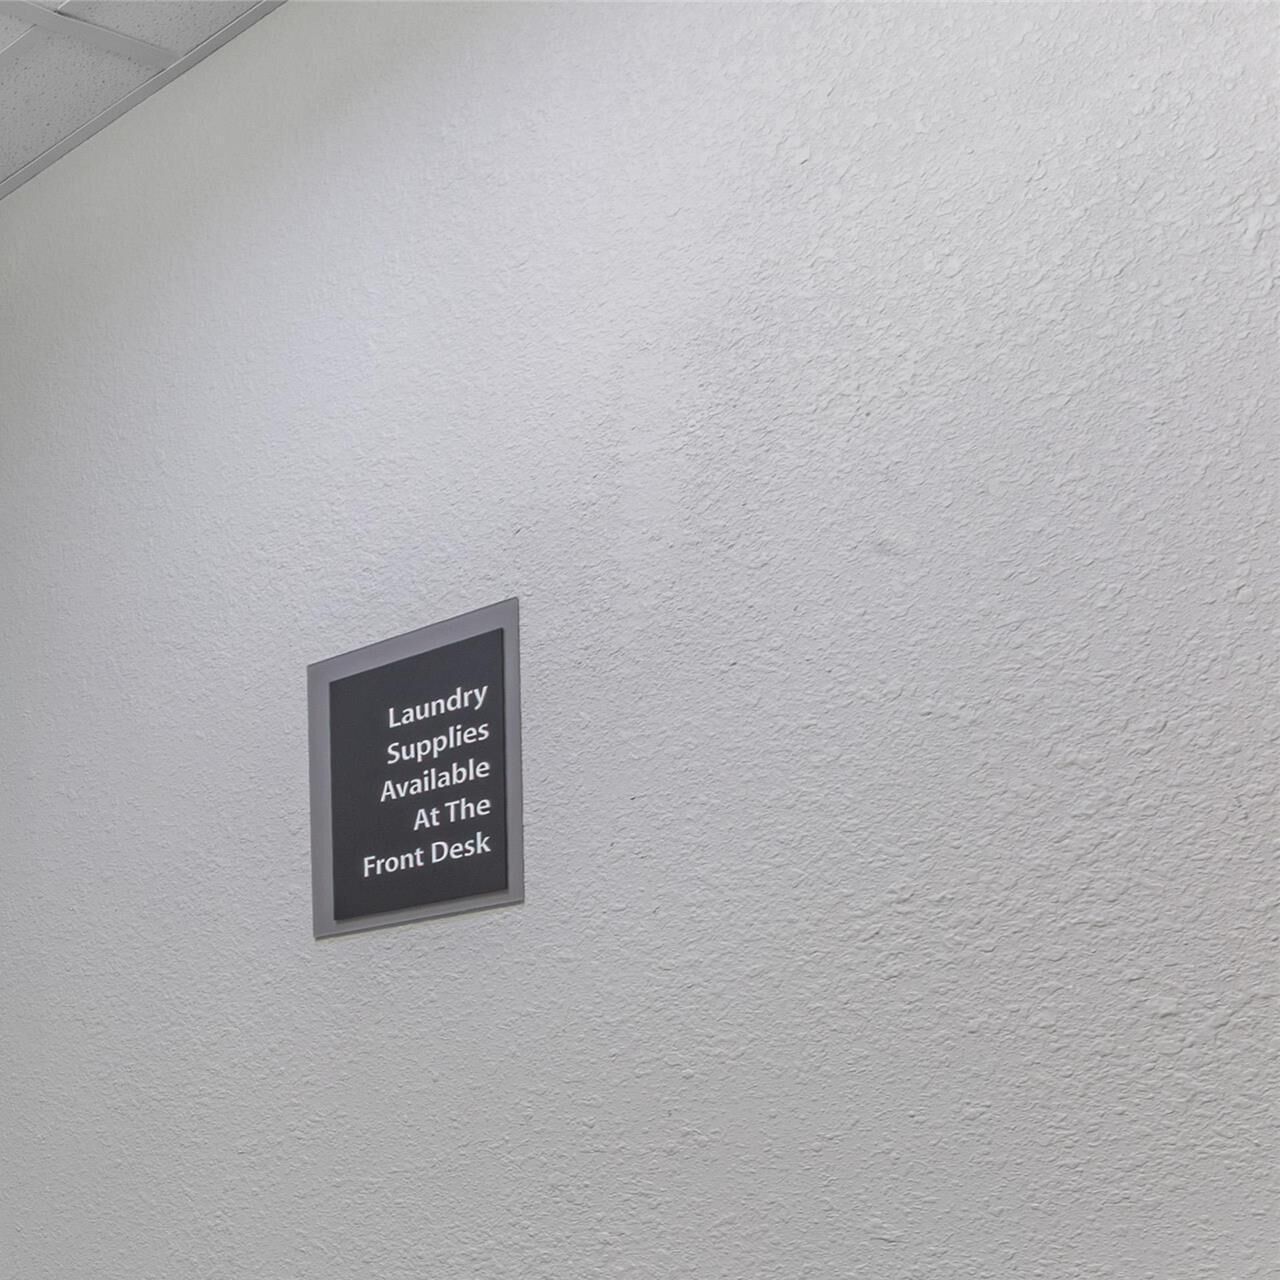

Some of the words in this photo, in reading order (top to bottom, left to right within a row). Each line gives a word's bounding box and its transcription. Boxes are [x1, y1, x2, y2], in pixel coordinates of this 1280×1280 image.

[388, 685, 489, 729] Laundry
[386, 723, 490, 765] Supplies
[379, 757, 491, 803] Available
[413, 807, 441, 831] At
[443, 797, 492, 823] The
[363, 847, 425, 878] Front
[431, 831, 492, 864] Desk
